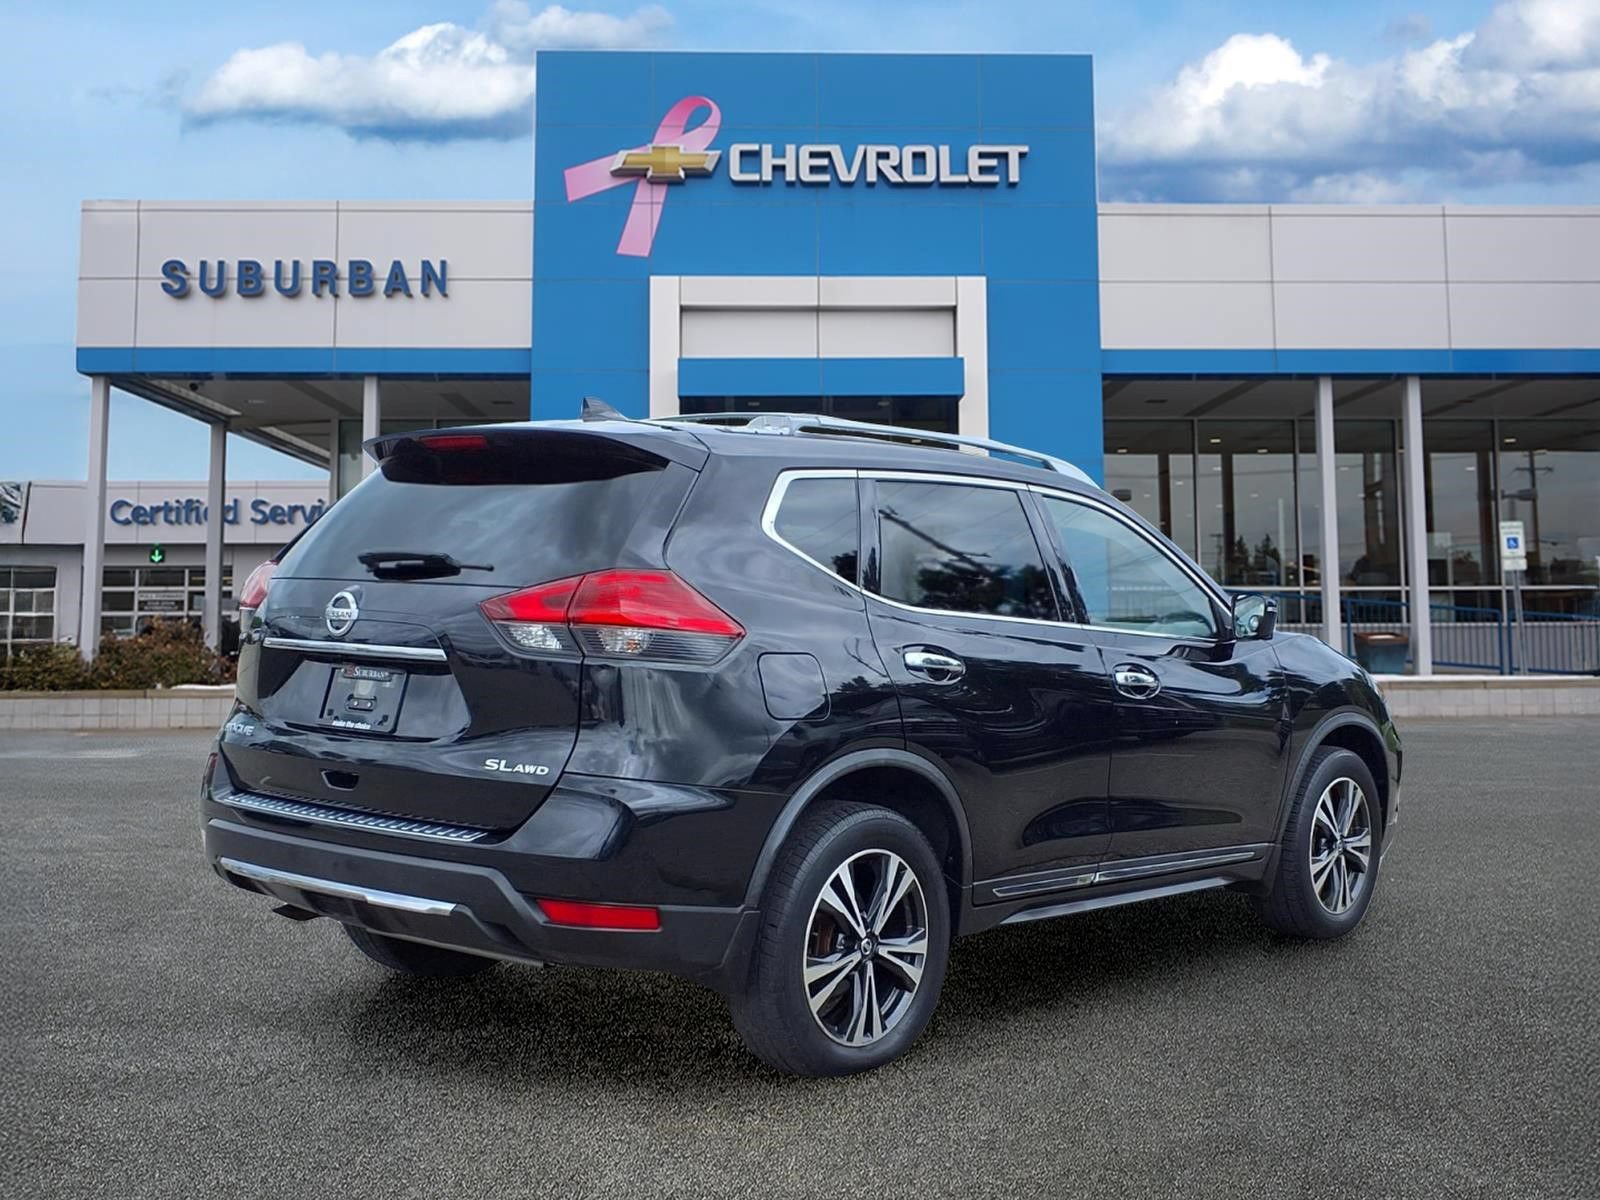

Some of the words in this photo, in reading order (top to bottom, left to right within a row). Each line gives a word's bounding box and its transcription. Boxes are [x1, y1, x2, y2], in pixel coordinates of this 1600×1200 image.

[729, 143, 1029, 183] CHEVROLET
[161, 259, 449, 298] SUBURBAN
[251, 499, 329, 525] Servi
[484, 758, 512, 772] SL
[513, 763, 549, 775] AWD
